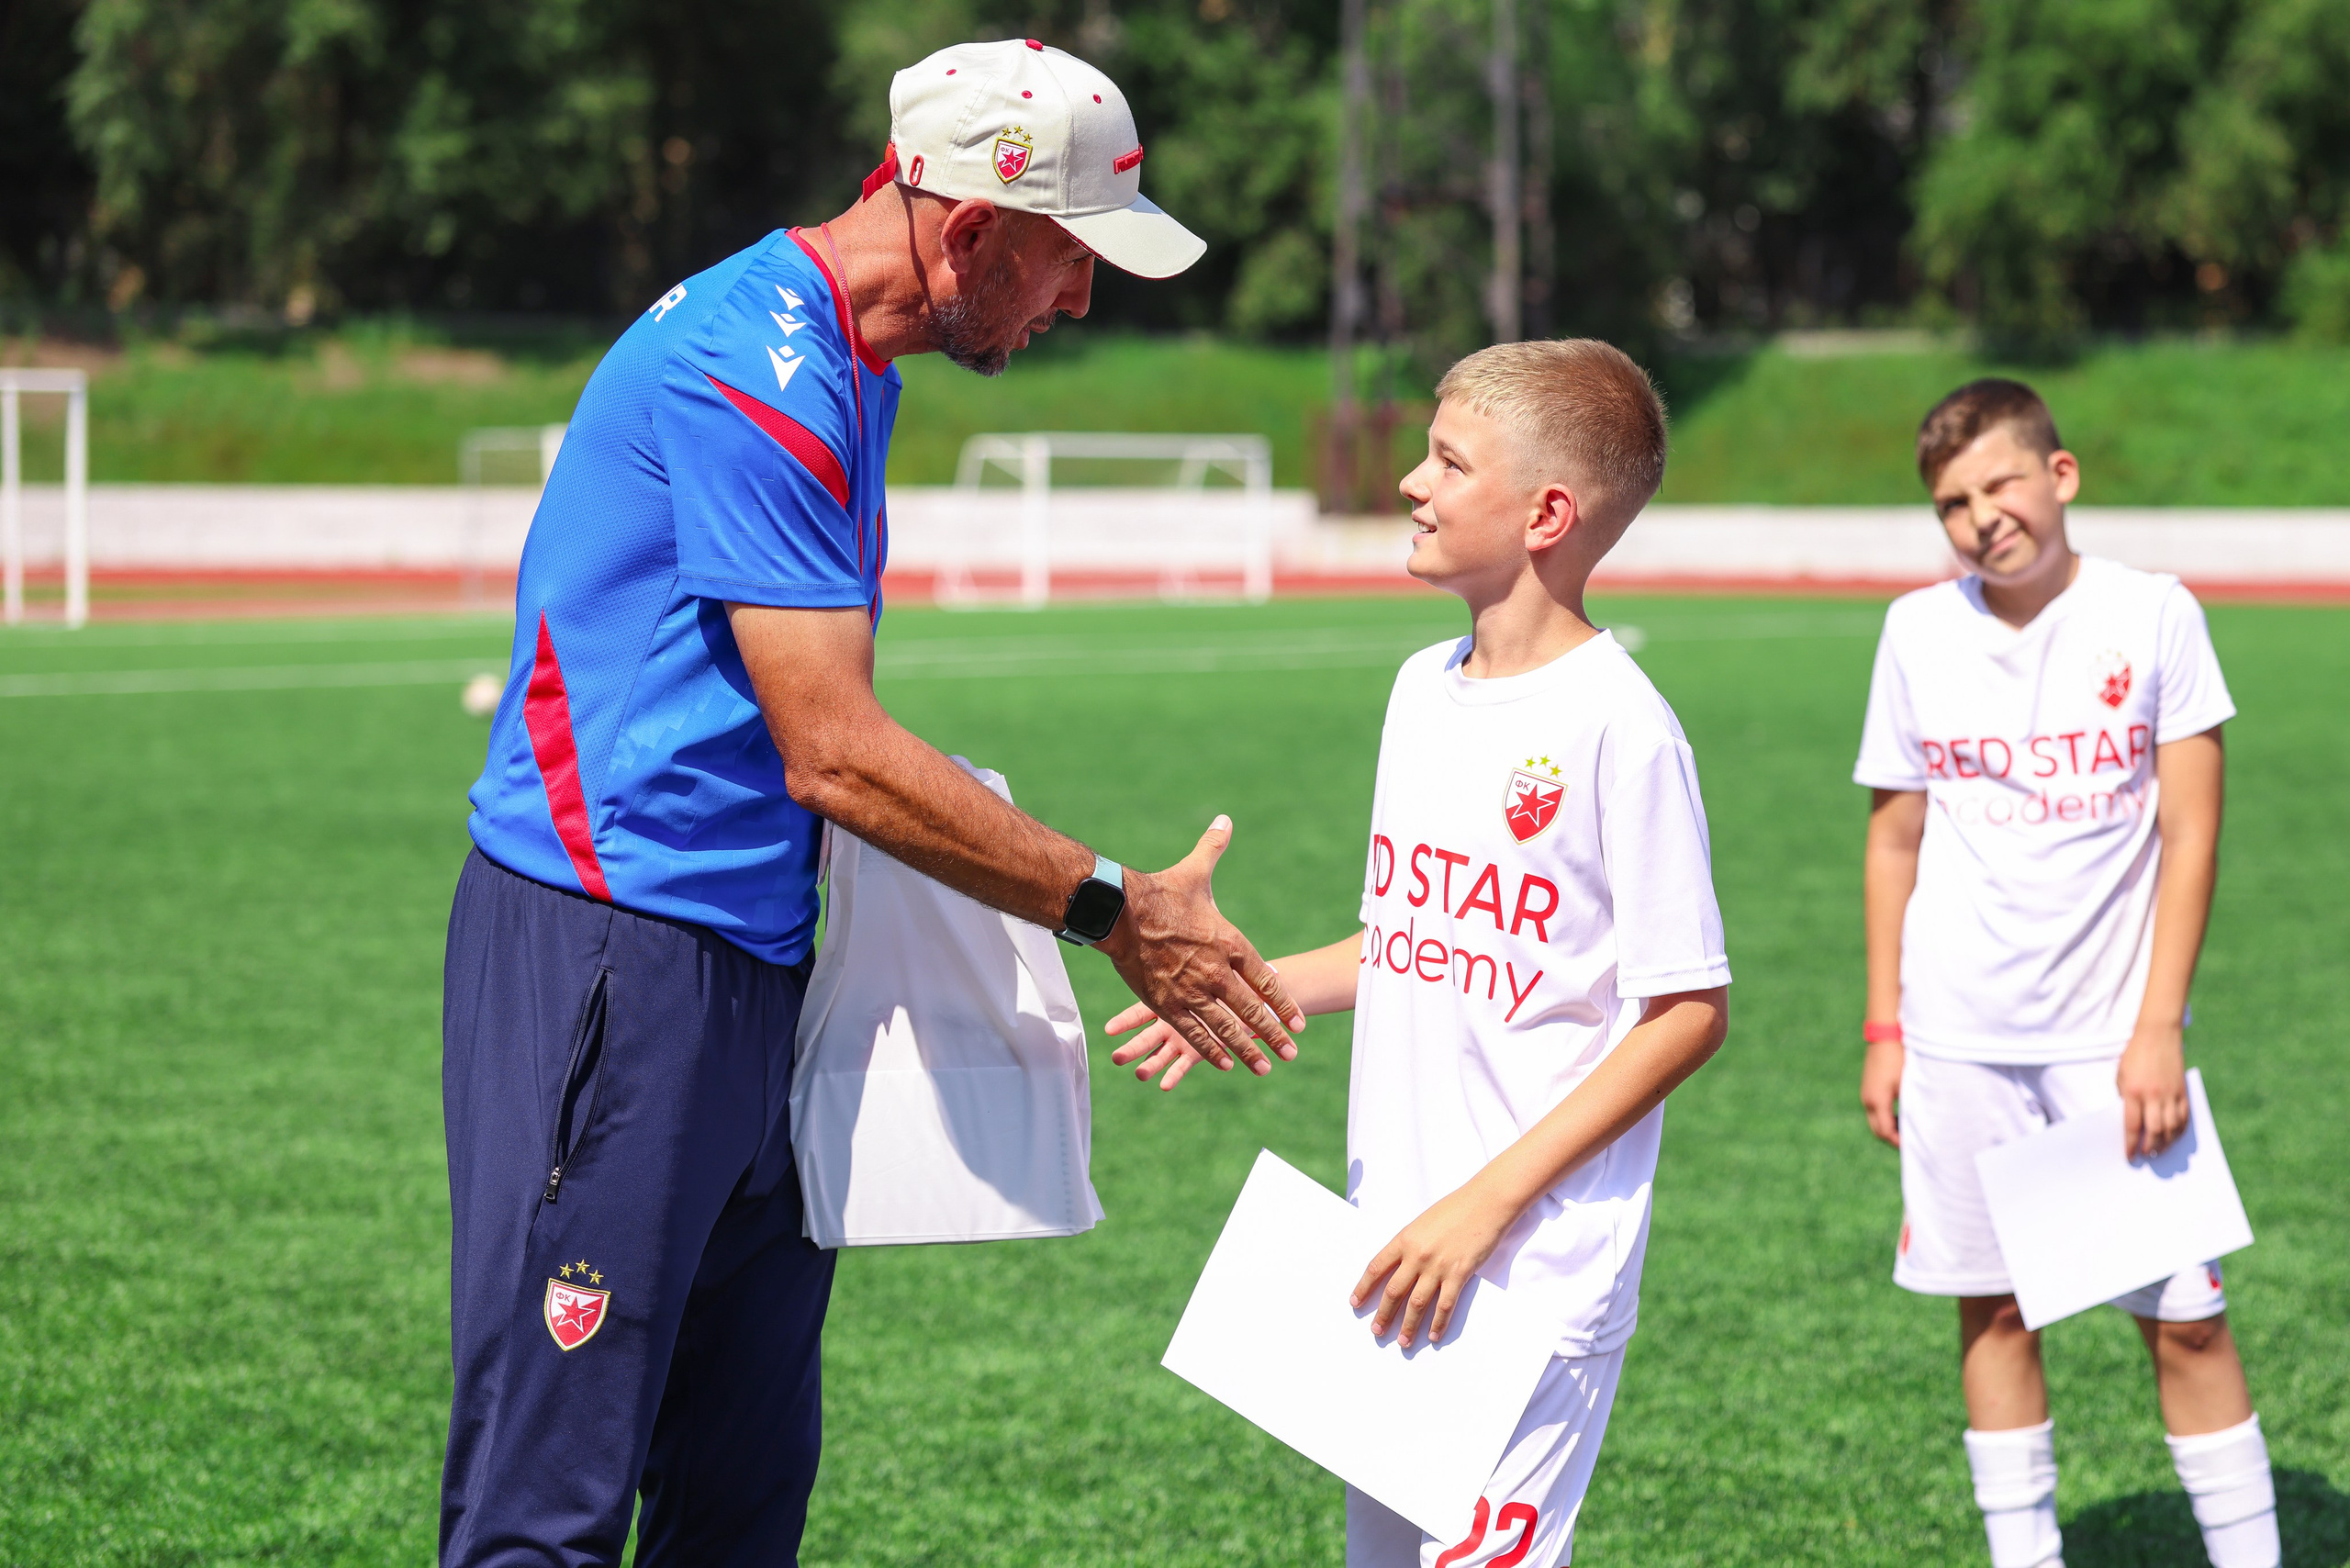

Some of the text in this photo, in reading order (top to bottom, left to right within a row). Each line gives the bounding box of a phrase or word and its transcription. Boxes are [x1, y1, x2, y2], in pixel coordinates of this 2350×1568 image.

[1921, 737, 2012, 779] RED
[1515, 779, 1530, 791] ФК
[1406, 843, 1560, 944] STAR
[555, 1292, 571, 1303] ФК
